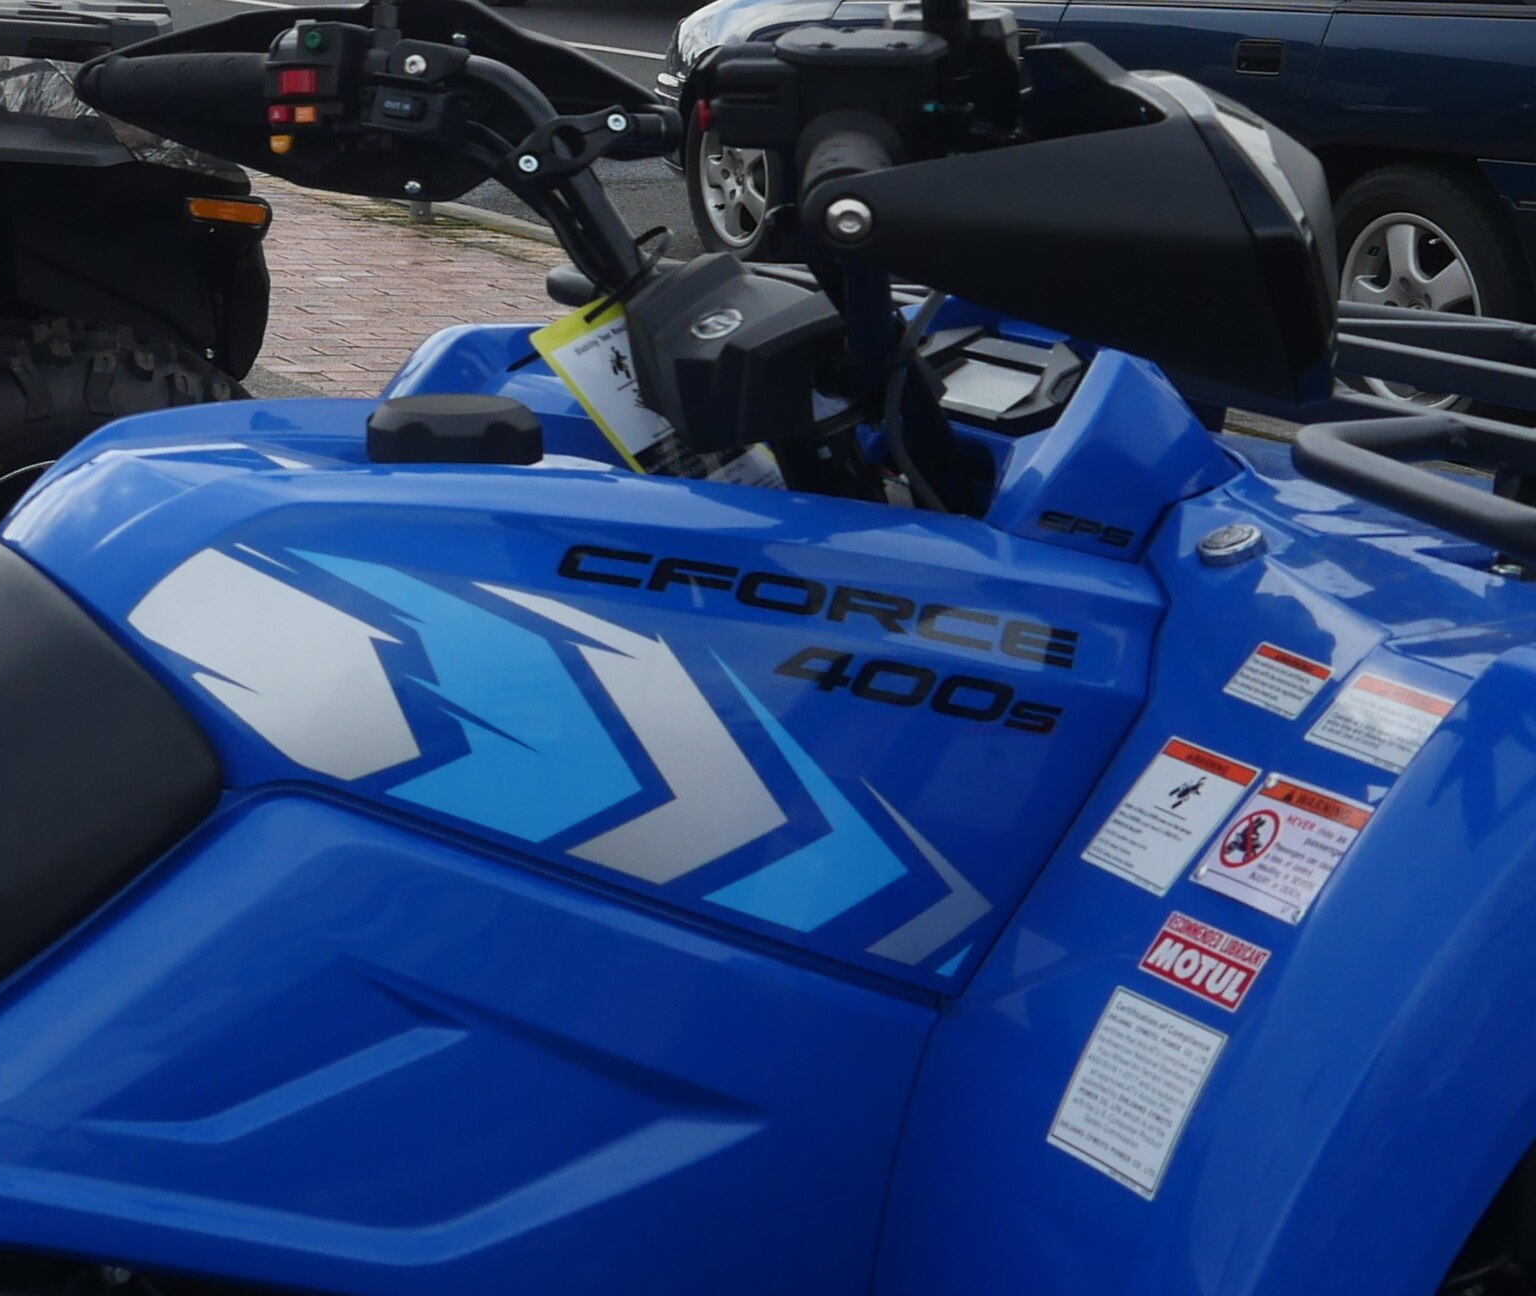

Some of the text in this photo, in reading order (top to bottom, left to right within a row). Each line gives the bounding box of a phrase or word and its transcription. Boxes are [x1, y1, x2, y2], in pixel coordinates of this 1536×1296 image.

[1037, 510, 1136, 548] EPS
[556, 544, 1081, 670] CFORCE
[1284, 814, 1318, 832] NEVER
[1301, 836, 1346, 859] passenge
[1166, 913, 1269, 967] RECOMMENDED LUBRICANT
[1146, 937, 1248, 1002] MOTUL
